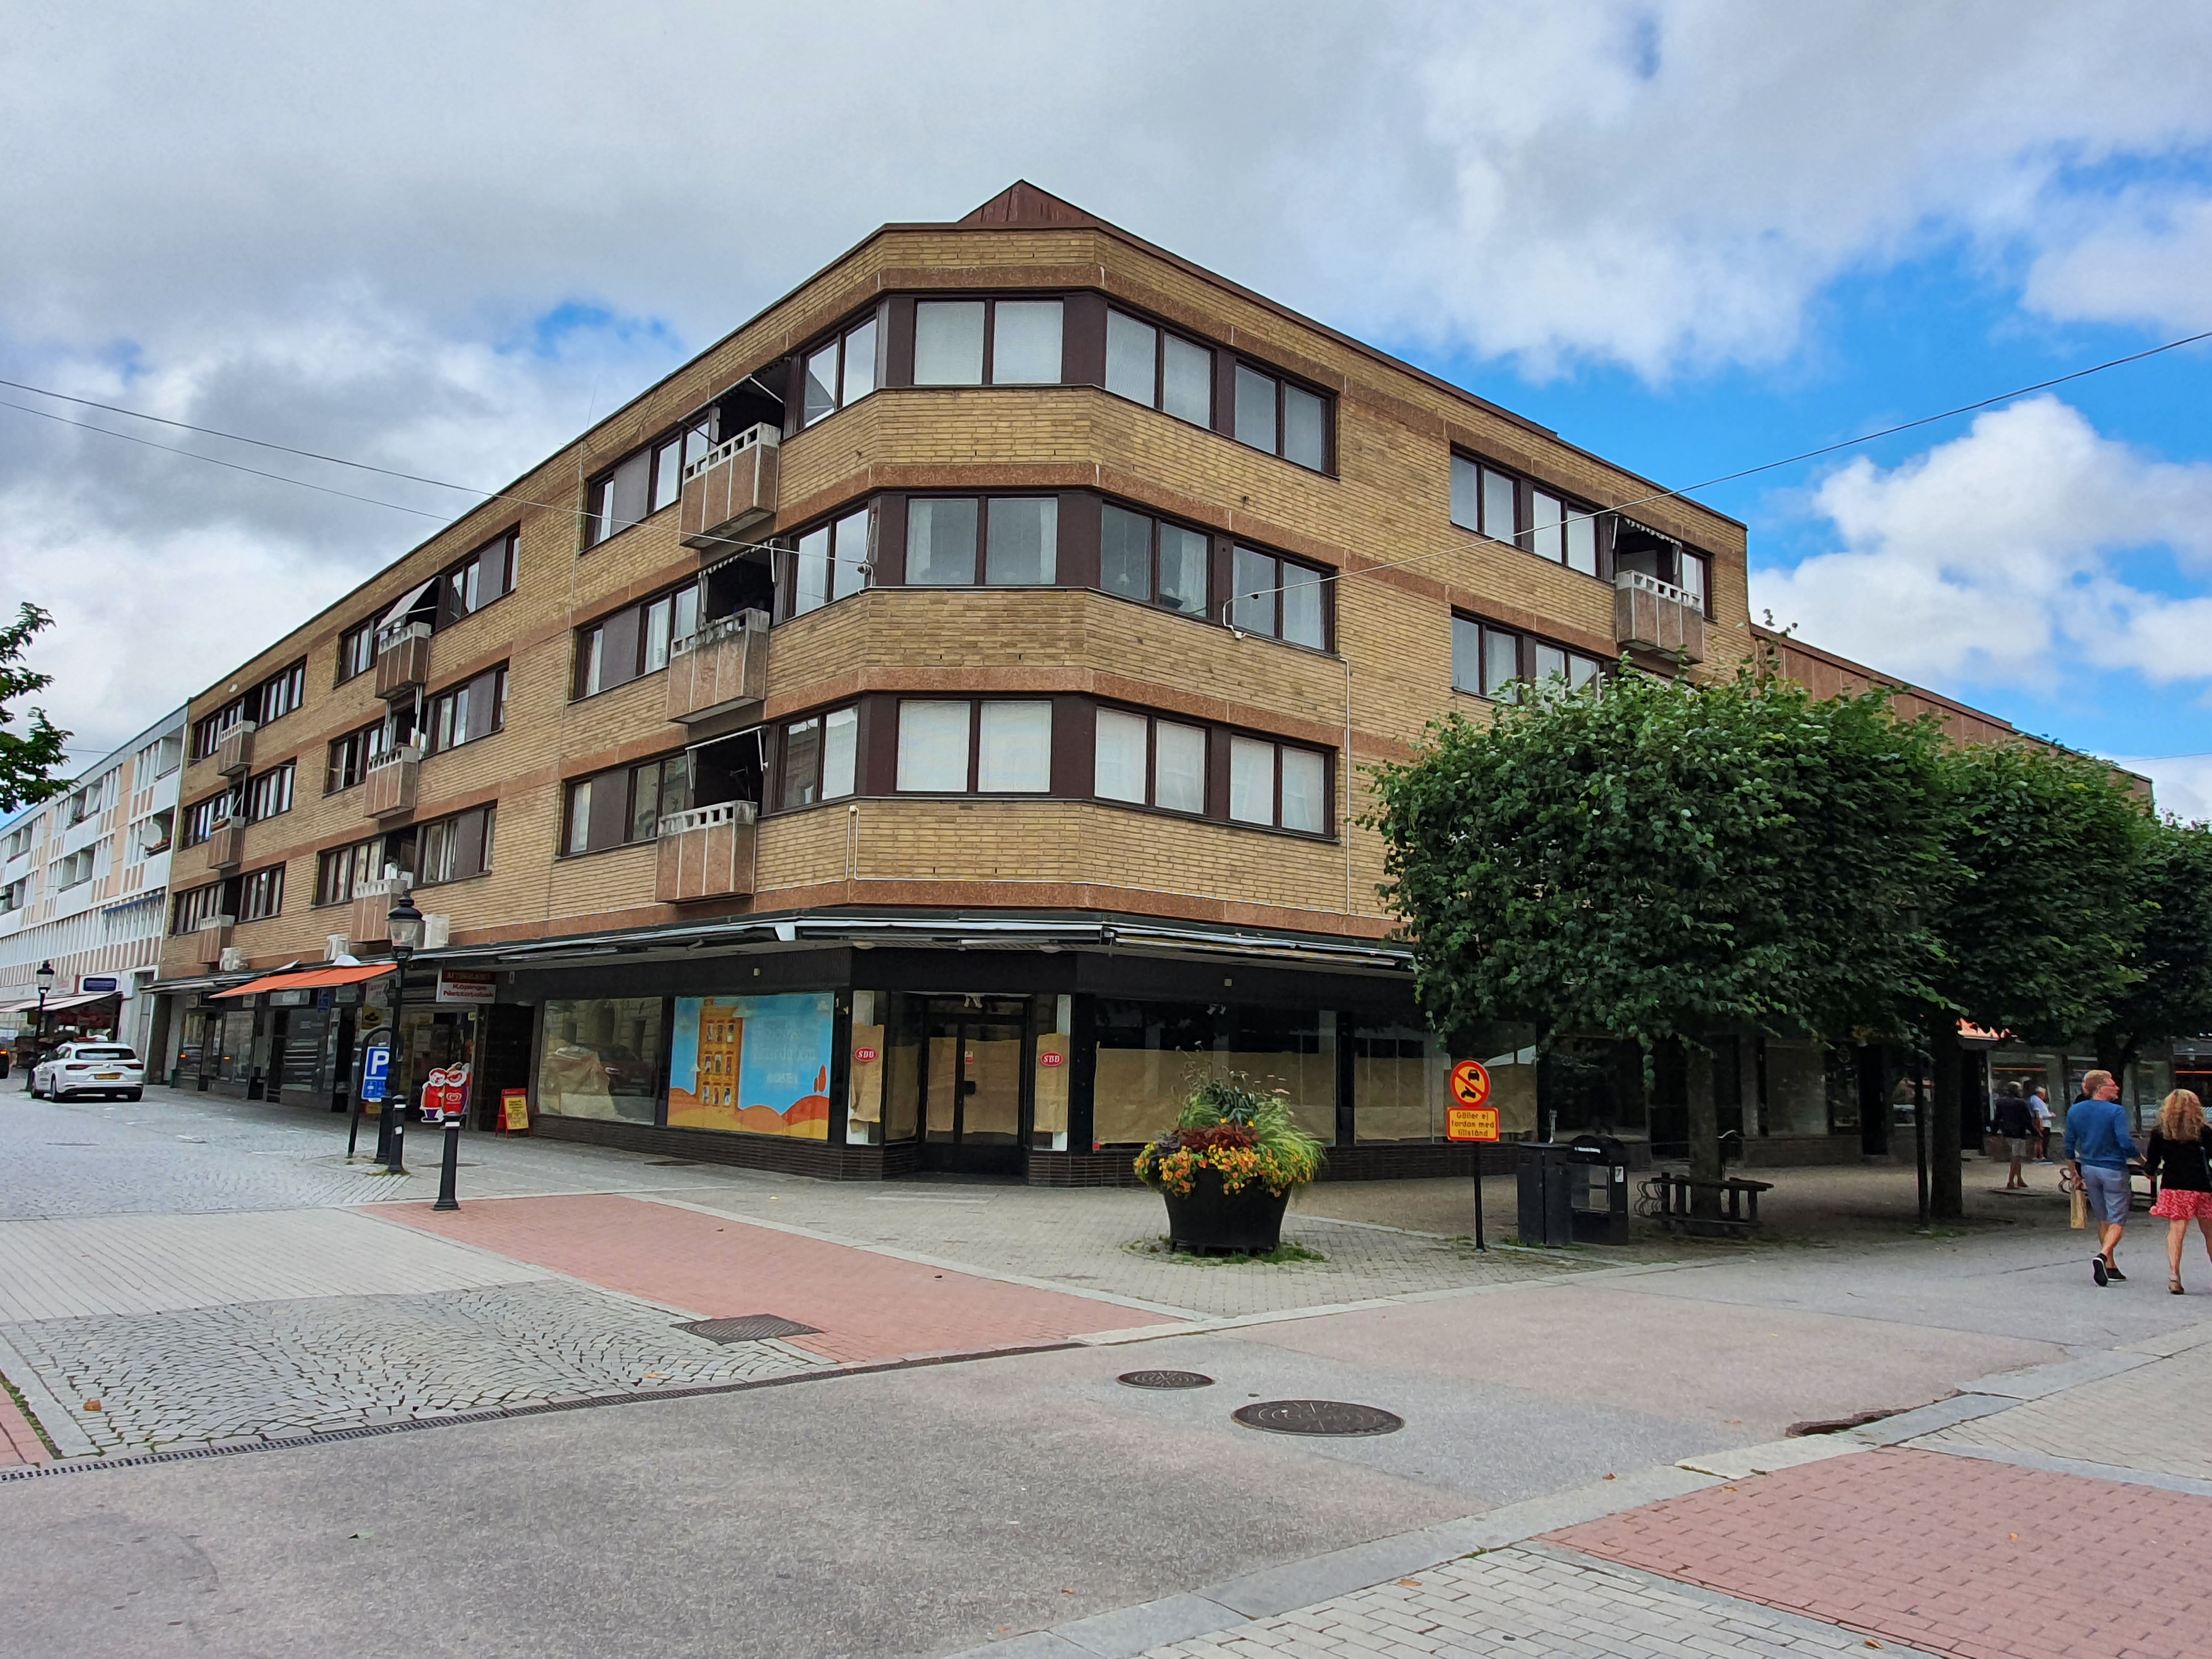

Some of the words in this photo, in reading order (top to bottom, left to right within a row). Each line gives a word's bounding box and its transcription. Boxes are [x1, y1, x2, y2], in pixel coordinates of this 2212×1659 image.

[371, 1050, 390, 1075] P
[1481, 1112, 1489, 1121] ej
[1451, 1119, 1476, 1127] fordon
[1478, 1120, 1495, 1129] med
